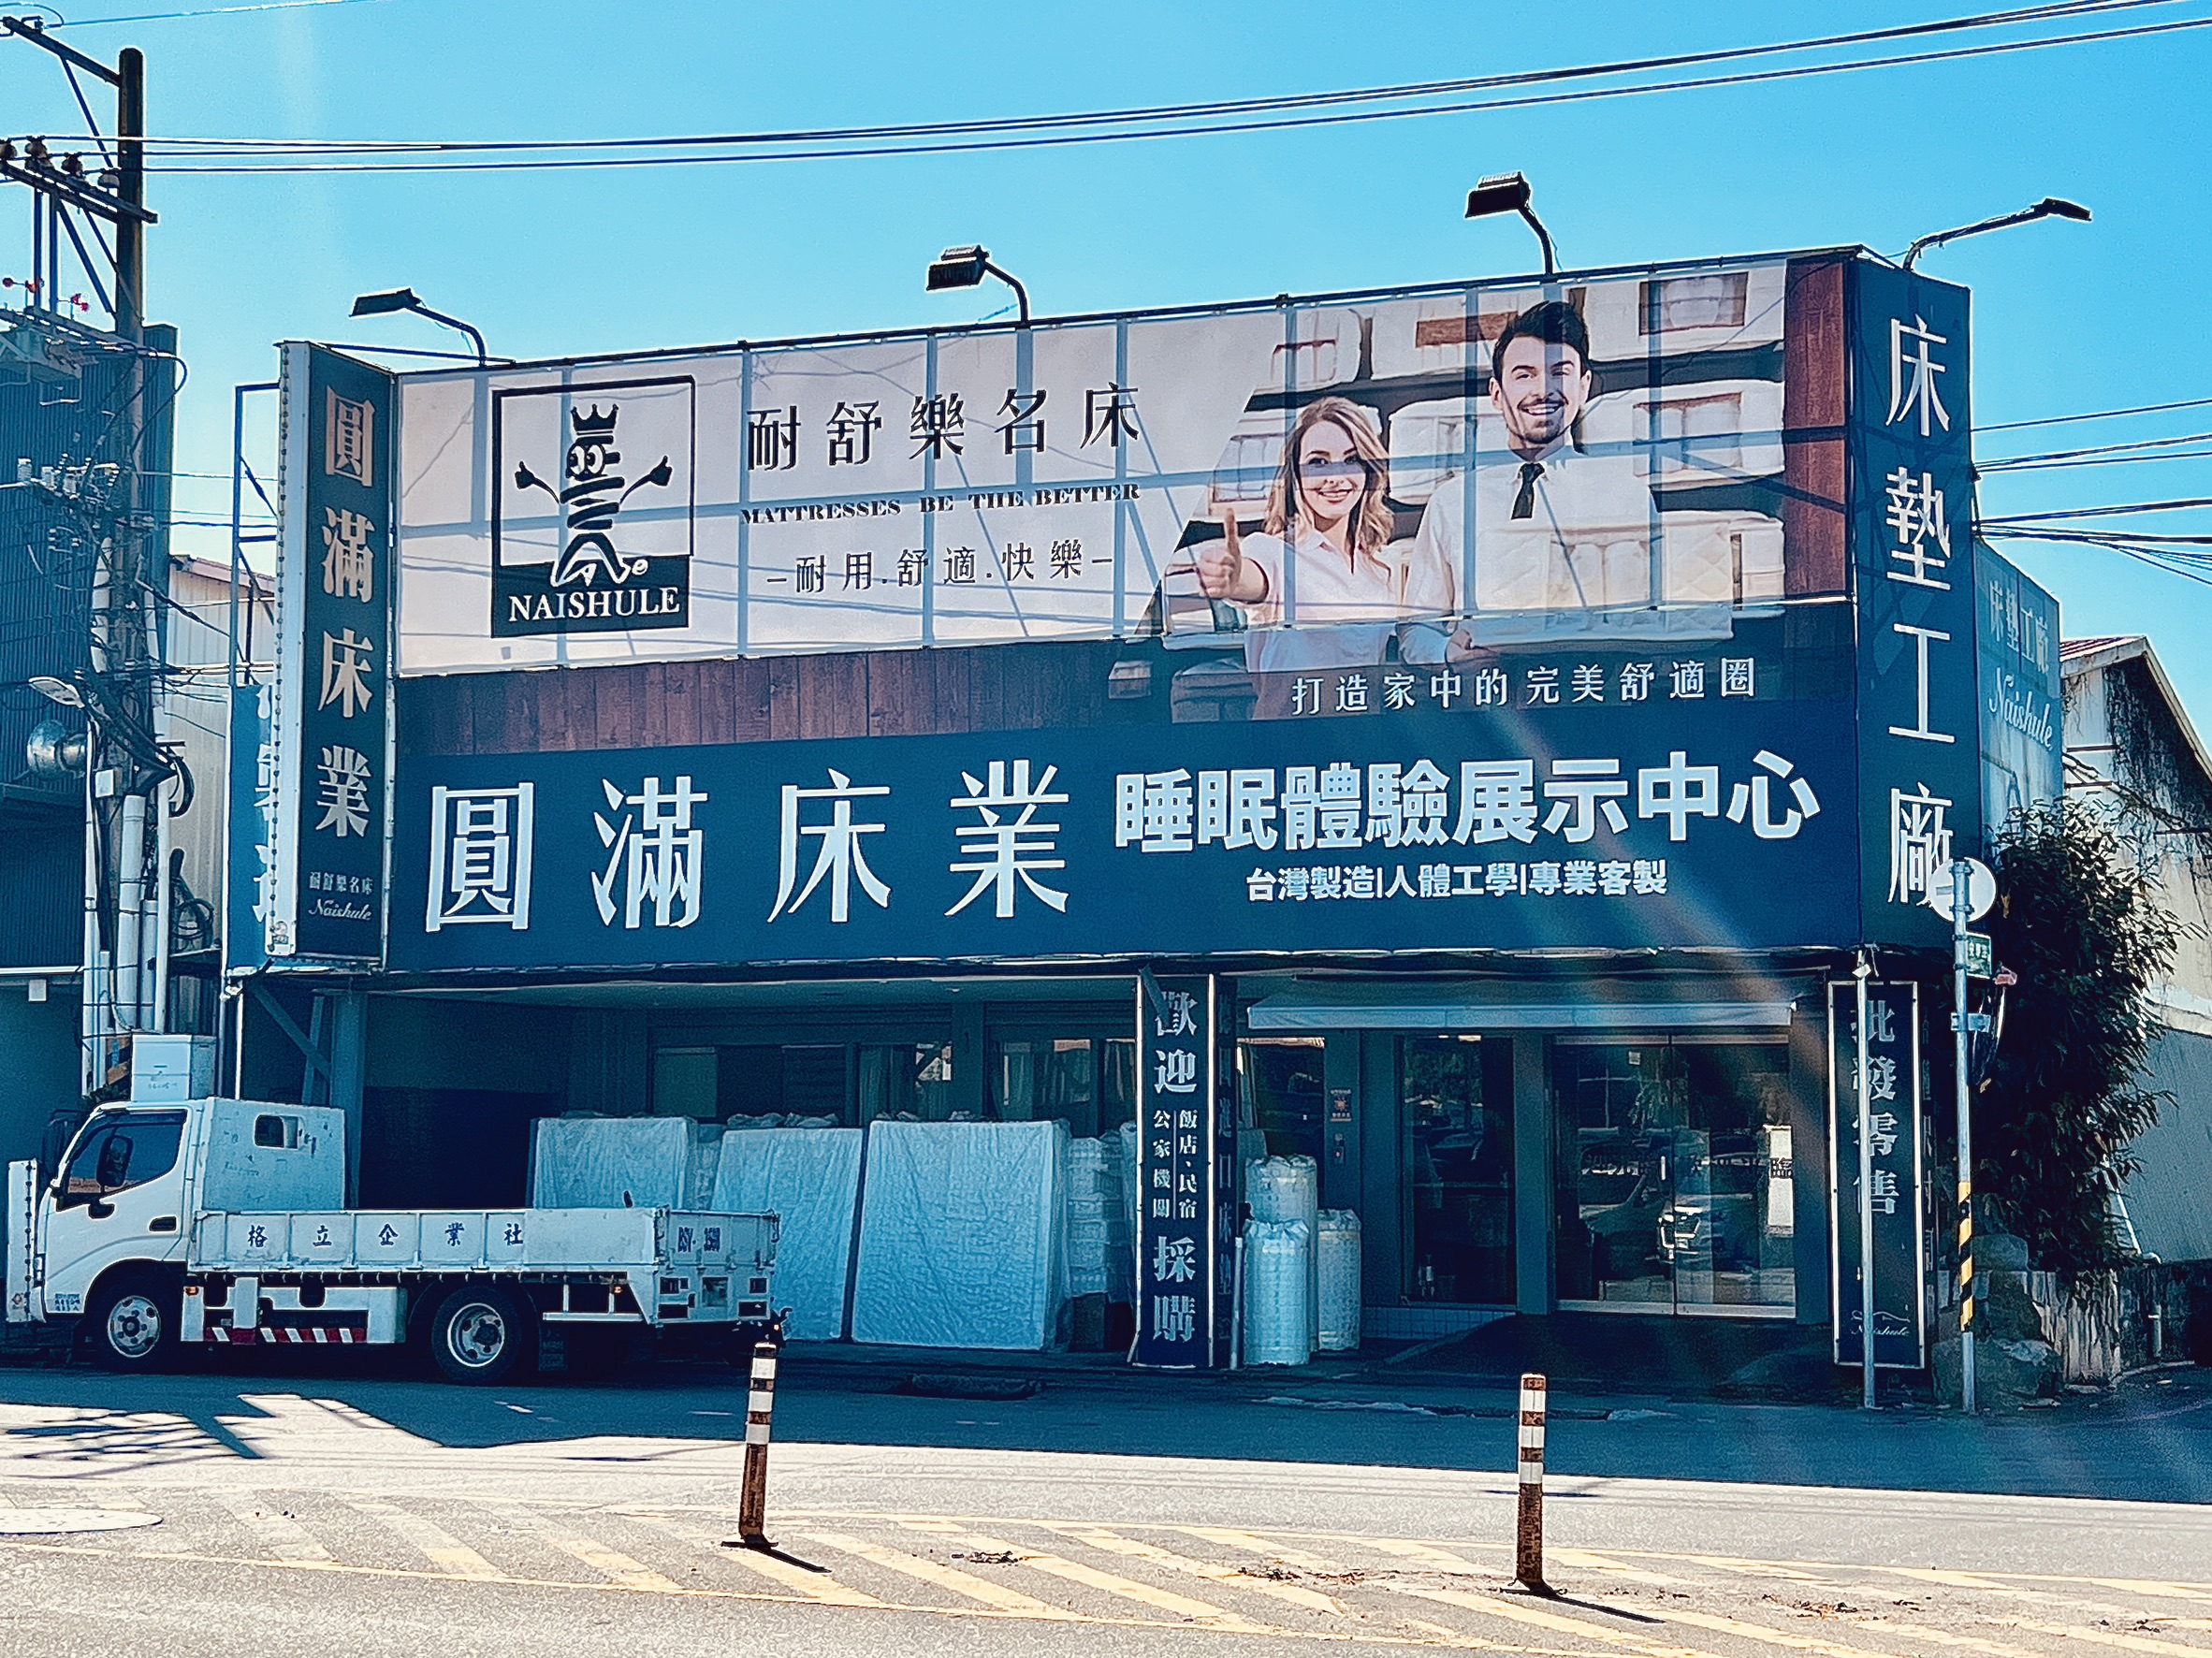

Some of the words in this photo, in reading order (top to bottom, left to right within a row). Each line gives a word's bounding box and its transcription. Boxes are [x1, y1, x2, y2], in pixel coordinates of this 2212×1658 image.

[747, 381, 1140, 471] 耐舒樂名床
[740, 499, 901, 525] MATTRESSES
[920, 495, 954, 514] BE
[968, 490, 1024, 510] THE
[1036, 483, 1141, 506] BETTER
[315, 385, 376, 837] 圓滿床業
[508, 586, 680, 622] NAISHULE
[1886, 313, 1955, 906] 床墊工廠
[1291, 657, 1757, 716] 打造家中的完美舒適圈
[1989, 667, 2053, 749] Naishule
[425, 759, 1070, 932] 圓滿床業
[1114, 749, 1821, 852] 睡眠體驗展示中心
[308, 898, 372, 921] Naishule
[1153, 991, 1198, 1094] 歡迎
[1153, 1110, 1171, 1218] 公家機關
[247, 1223, 524, 1248] 格立企業社
[1152, 1235, 1197, 1343] 採購
